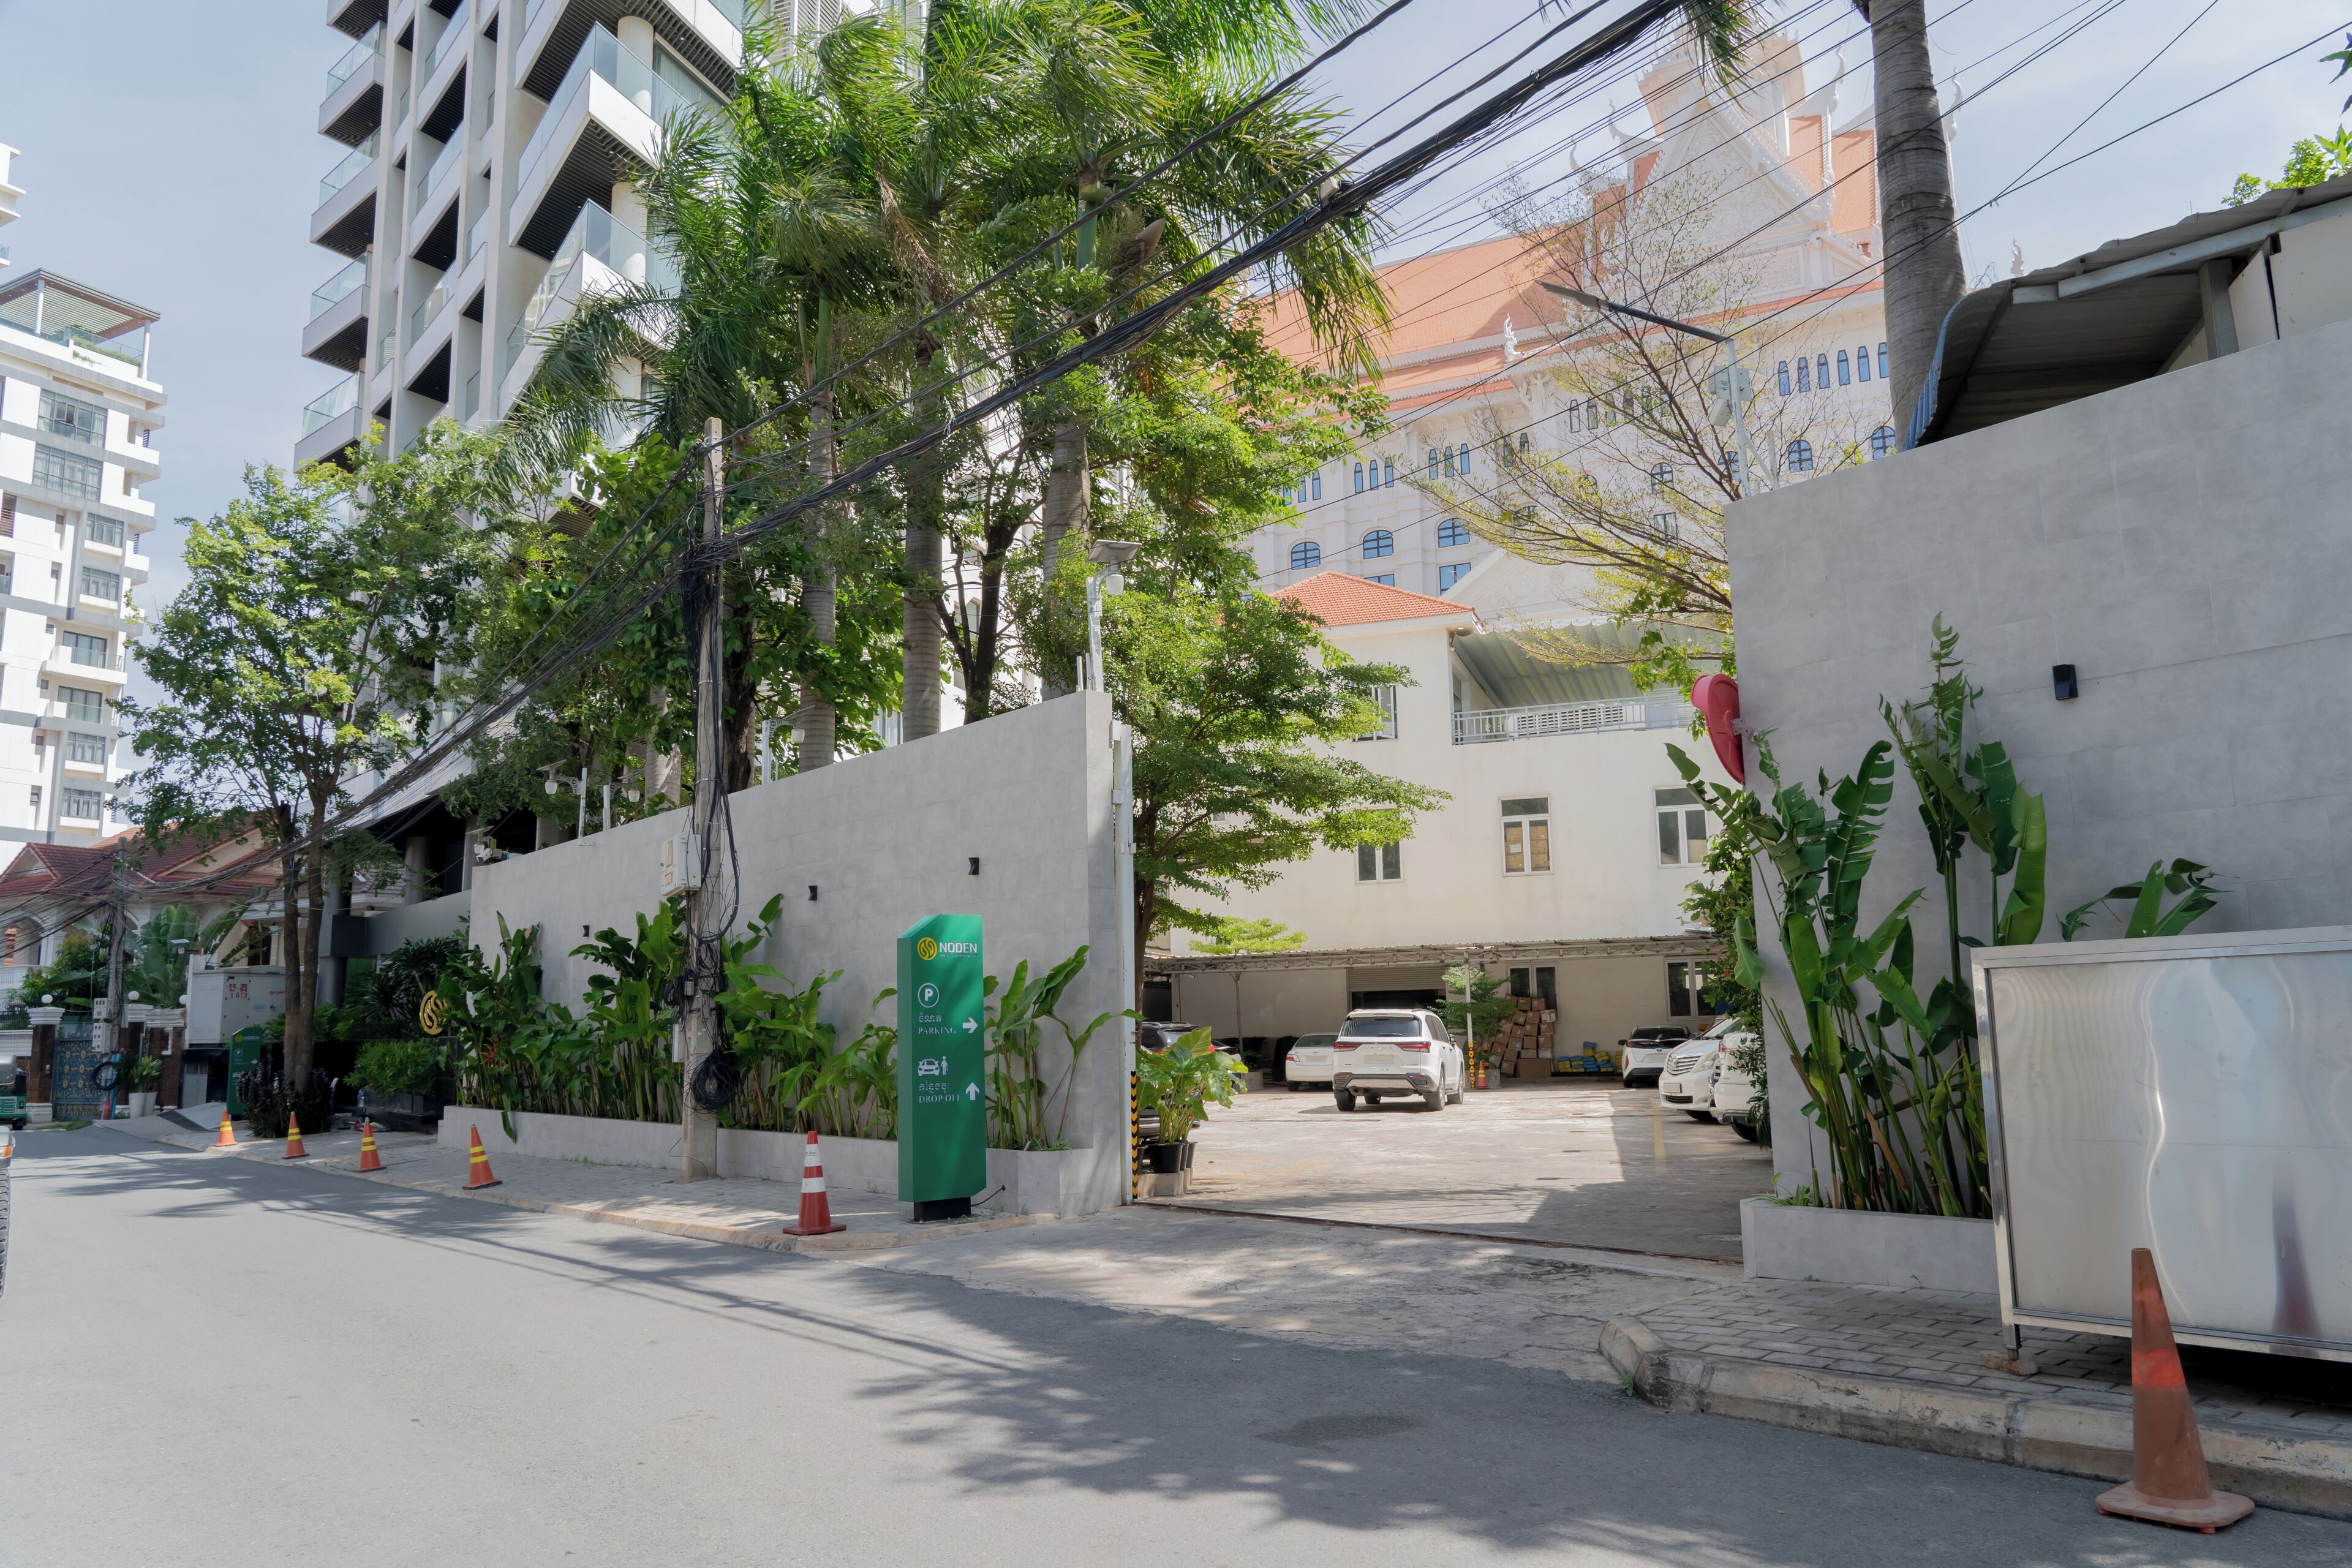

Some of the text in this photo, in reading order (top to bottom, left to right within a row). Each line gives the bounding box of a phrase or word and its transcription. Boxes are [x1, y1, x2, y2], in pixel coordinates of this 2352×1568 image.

[940, 942, 977, 953] NODEN
[925, 988, 933, 1001] P
[919, 1095, 943, 1103] DROP
